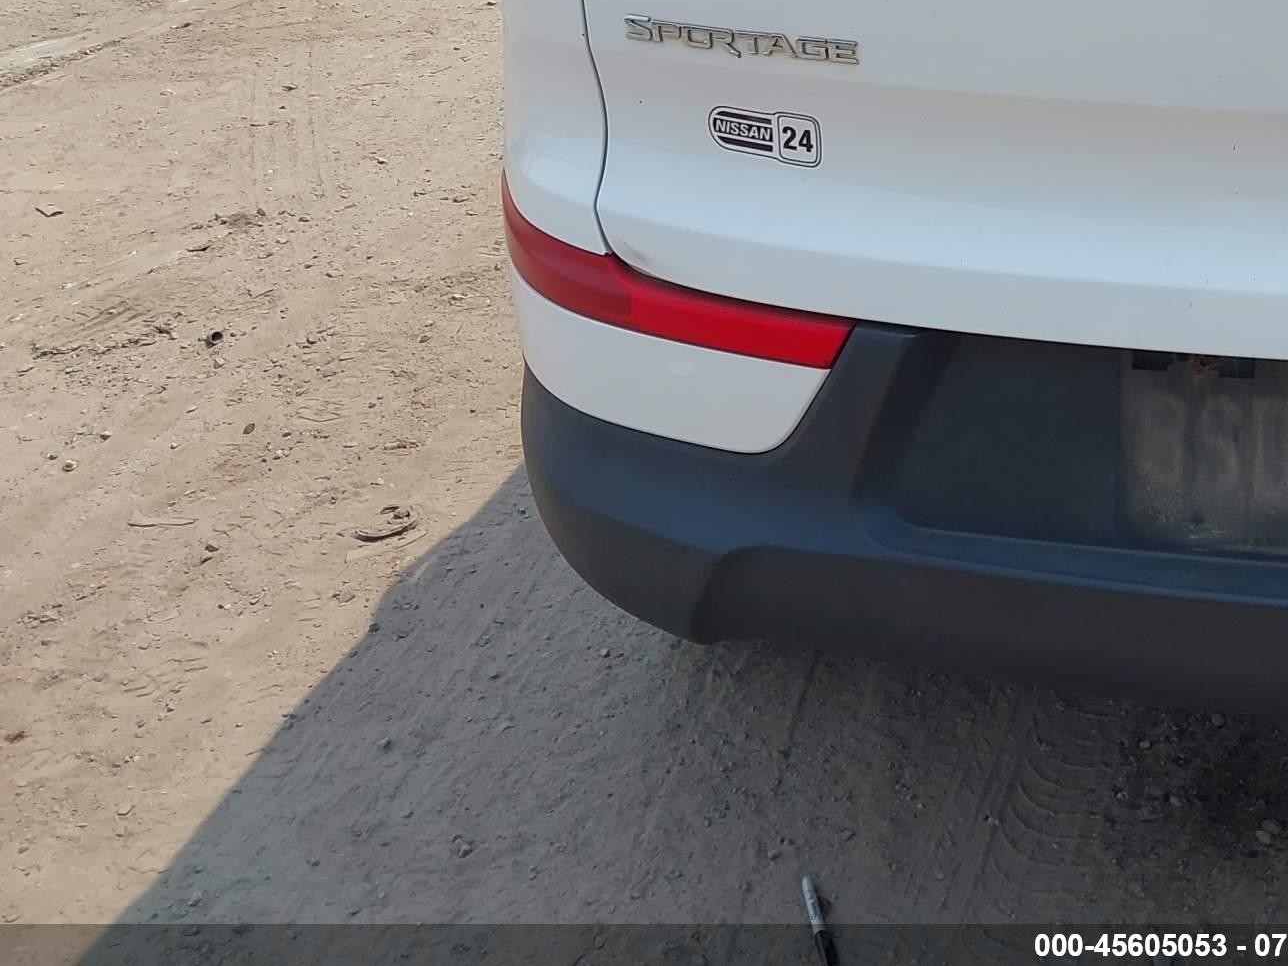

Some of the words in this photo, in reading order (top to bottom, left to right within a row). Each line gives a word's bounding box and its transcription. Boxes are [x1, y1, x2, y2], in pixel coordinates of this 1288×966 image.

[624, 13, 859, 65] SPORTAGE
[714, 118, 772, 142] NISSAN
[781, 125, 814, 153] 24
